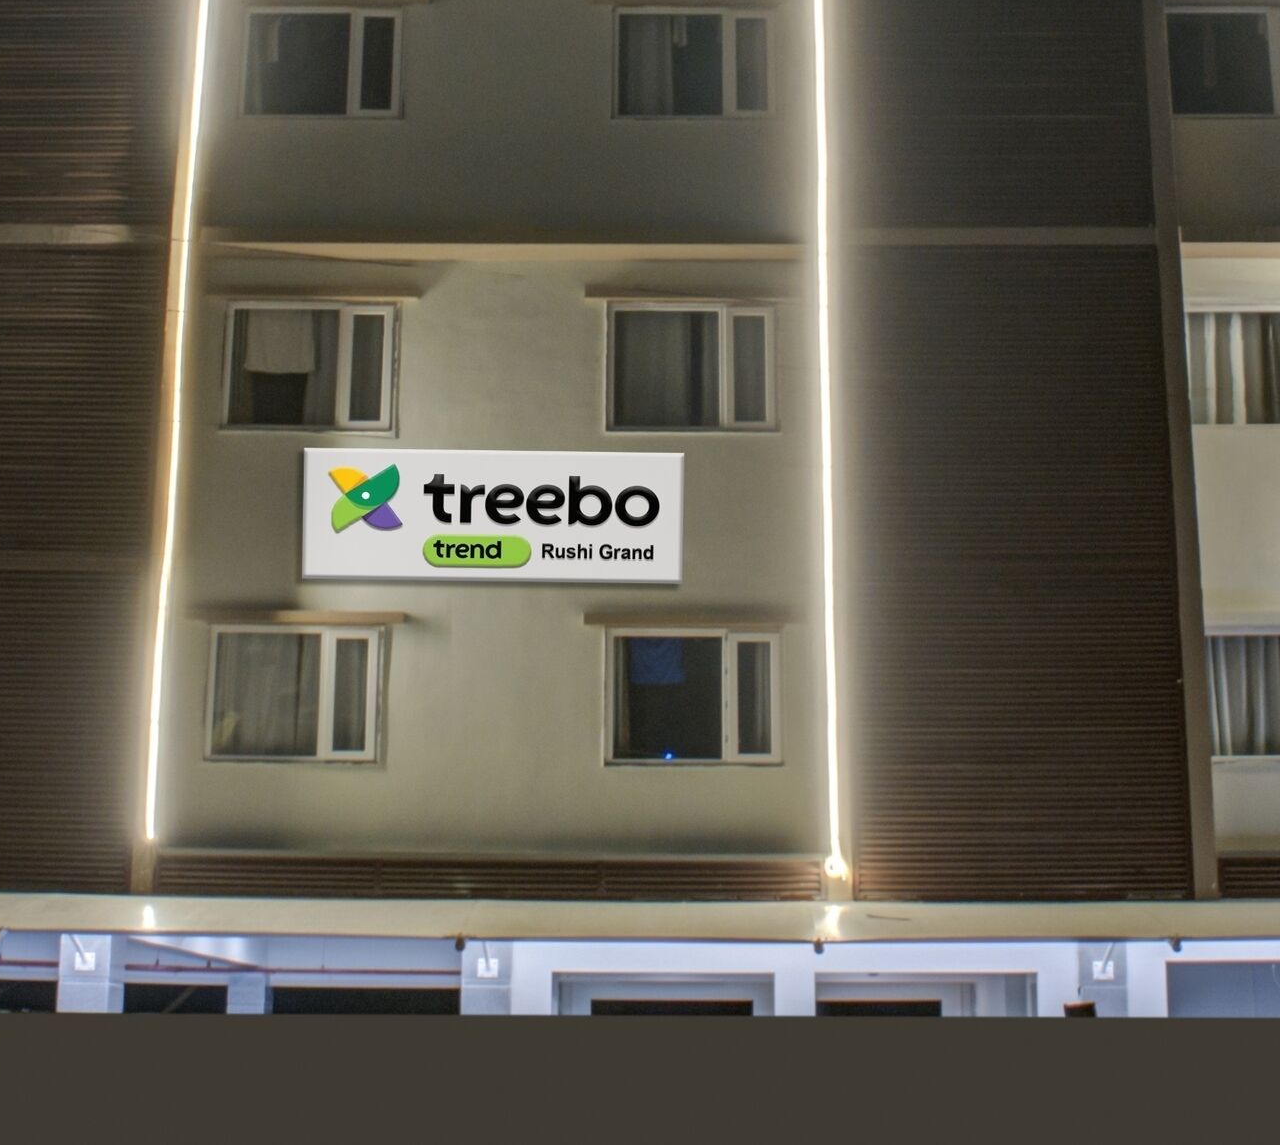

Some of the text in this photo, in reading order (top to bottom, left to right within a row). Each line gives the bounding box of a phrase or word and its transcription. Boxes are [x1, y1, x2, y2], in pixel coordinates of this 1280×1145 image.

[423, 473, 660, 527] treebo
[433, 539, 502, 560] trend
[541, 543, 654, 561] Rushi Grand
